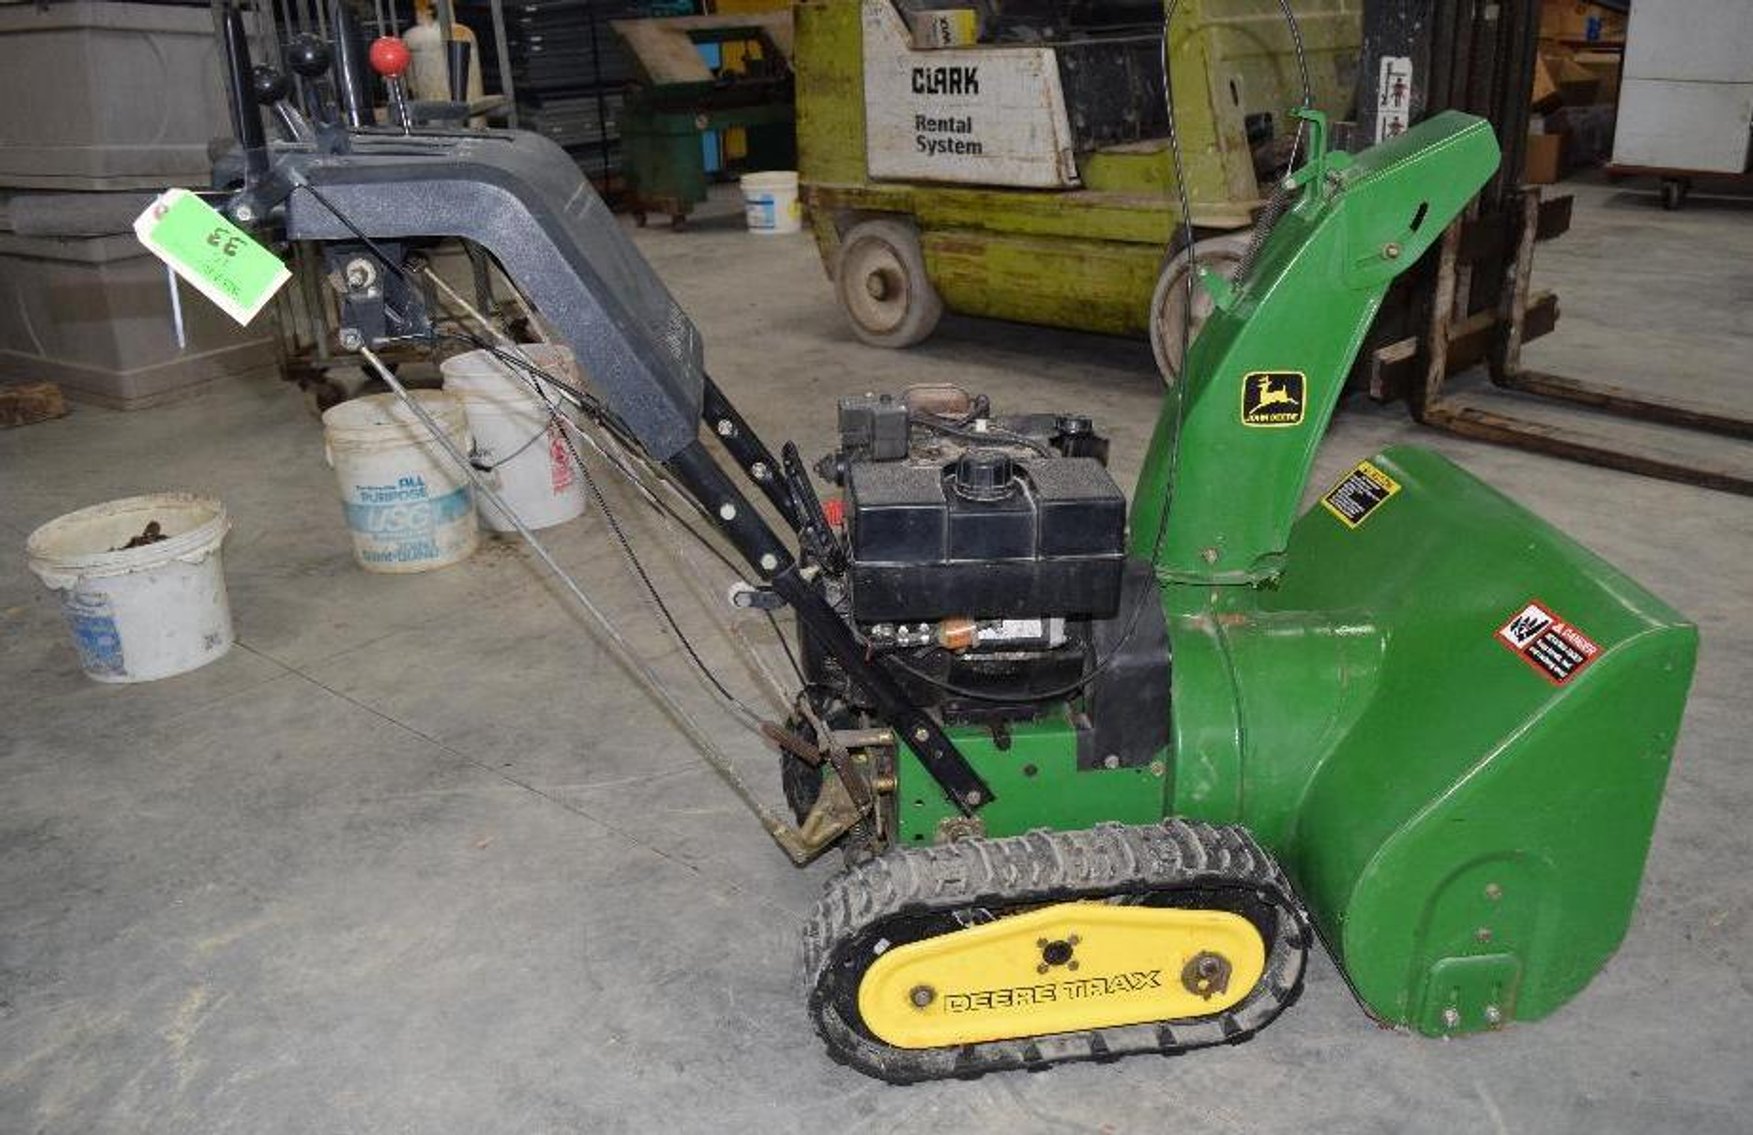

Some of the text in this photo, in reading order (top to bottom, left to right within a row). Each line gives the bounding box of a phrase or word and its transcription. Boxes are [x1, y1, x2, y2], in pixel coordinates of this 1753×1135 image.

[911, 66, 980, 96] CLARK
[914, 114, 972, 134] Rental
[916, 134, 983, 157] System
[944, 969, 1163, 1013] DEERE TRAX
